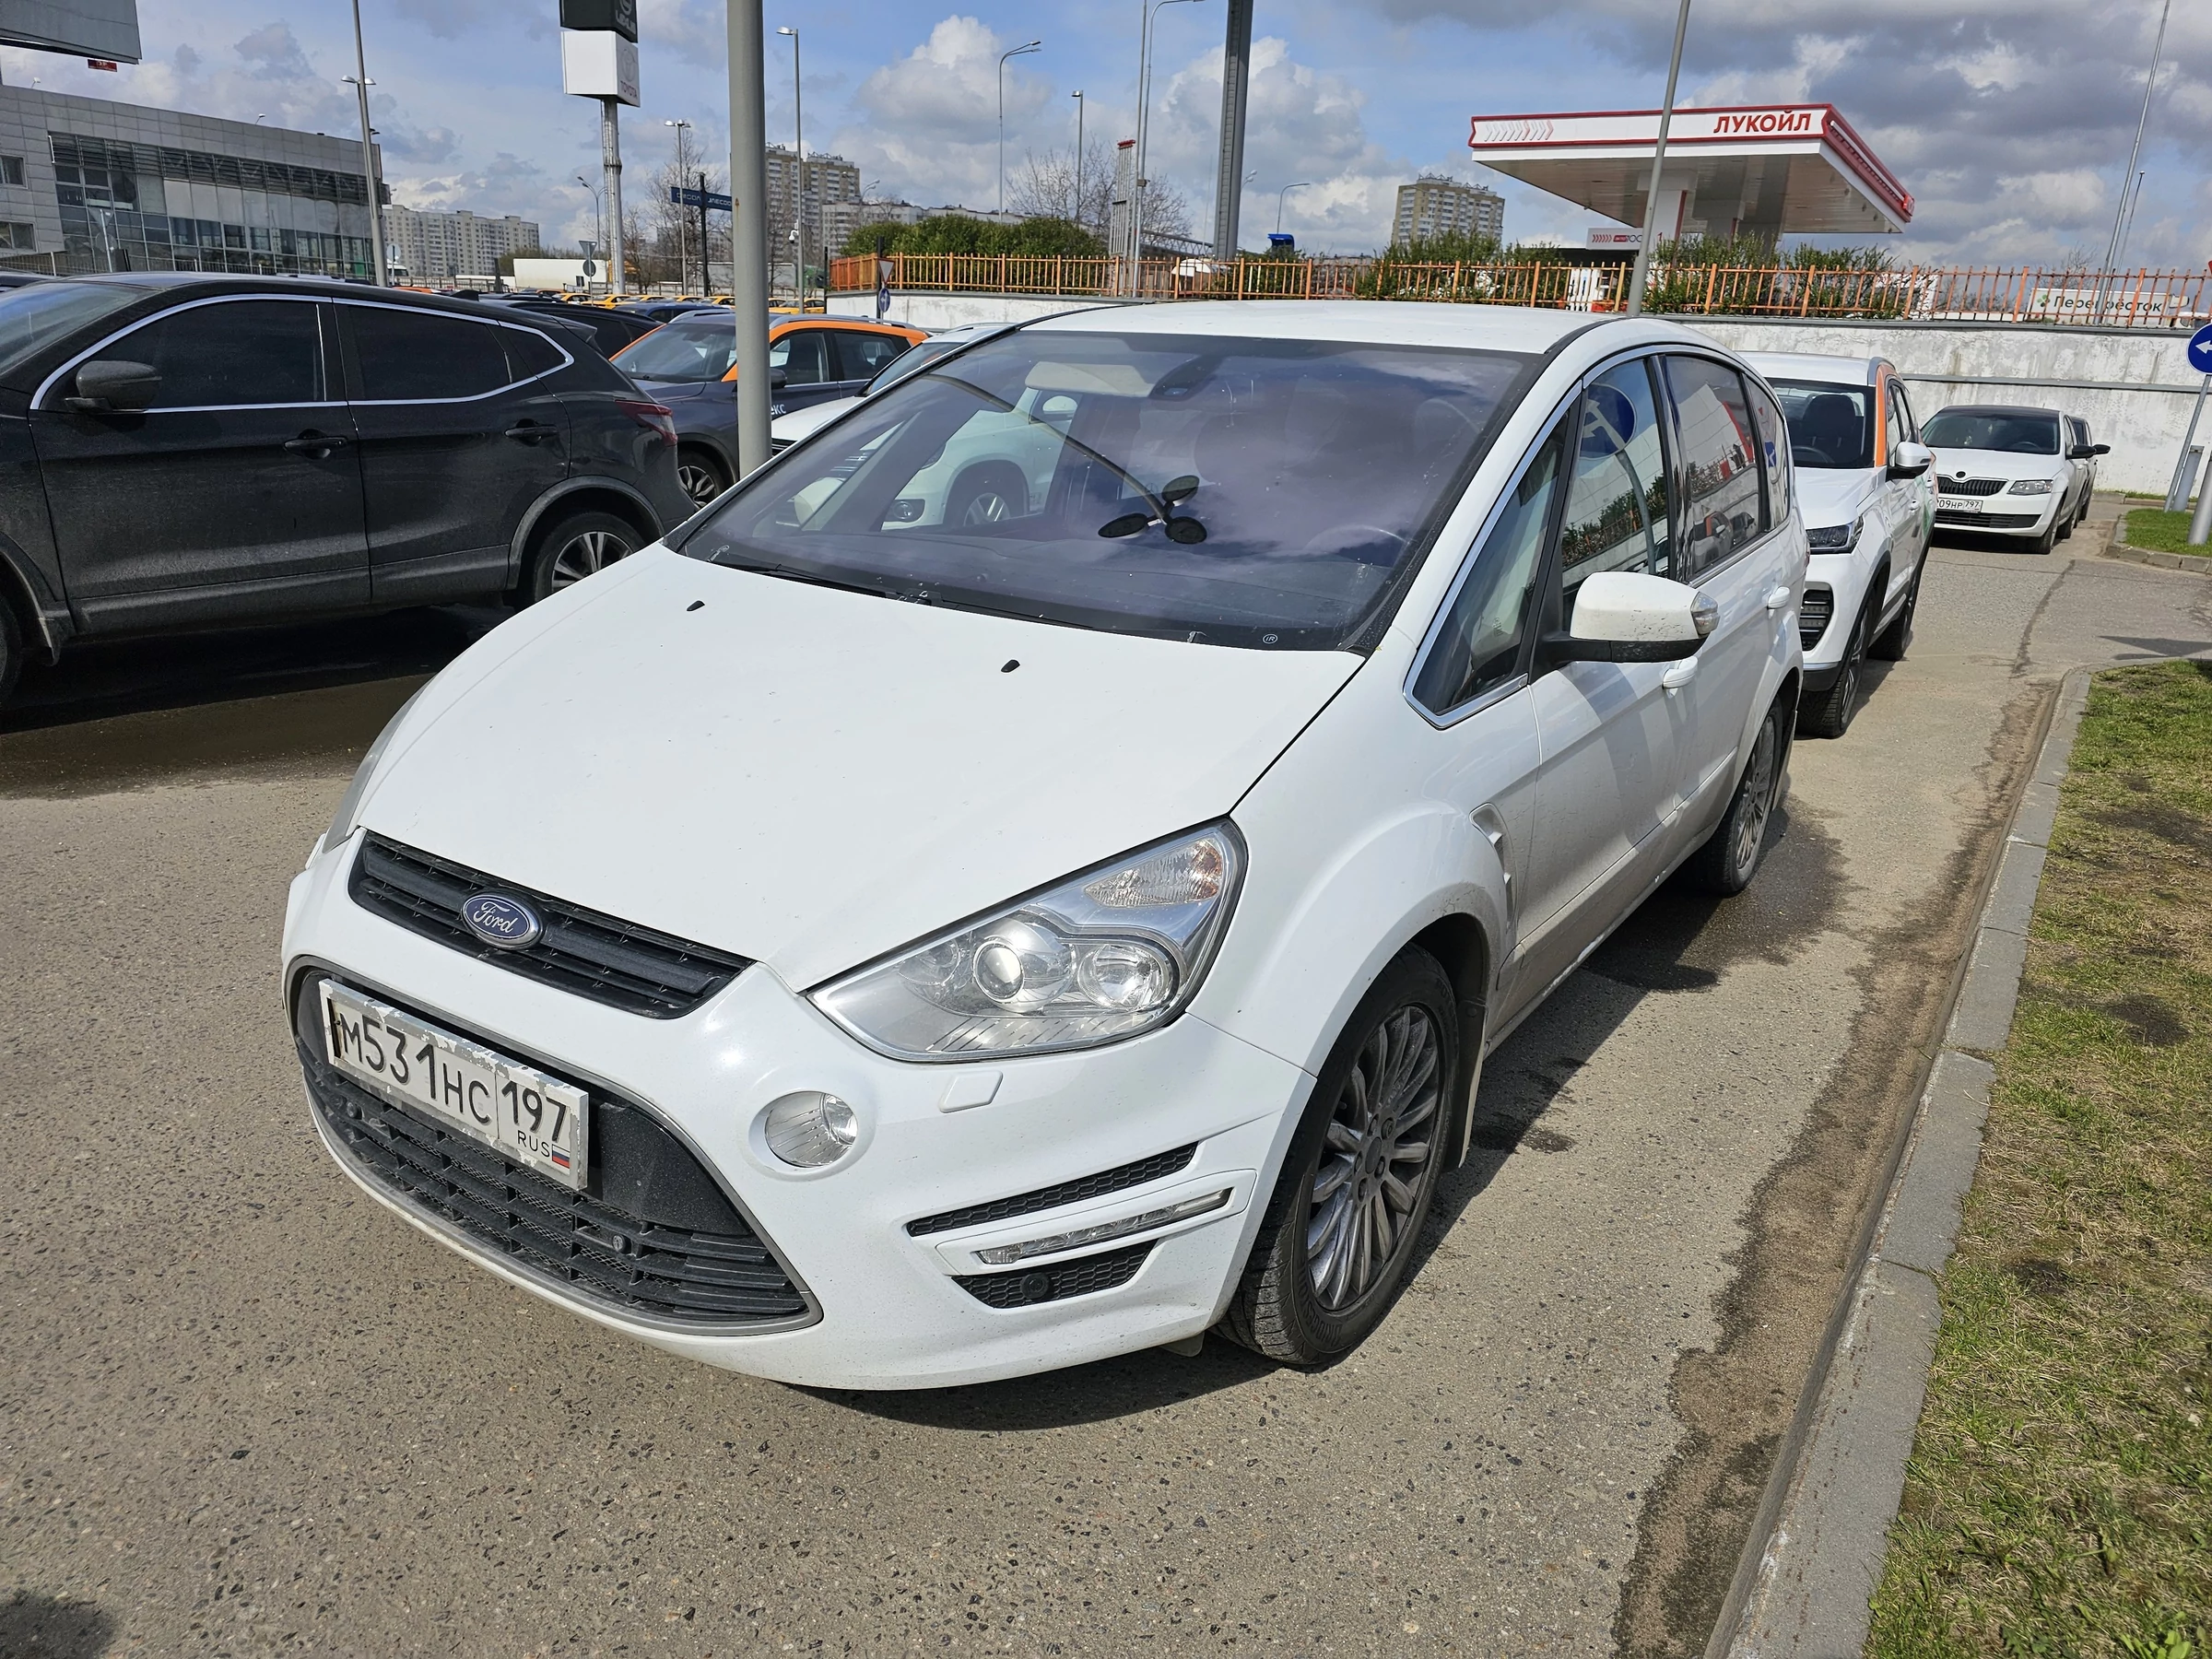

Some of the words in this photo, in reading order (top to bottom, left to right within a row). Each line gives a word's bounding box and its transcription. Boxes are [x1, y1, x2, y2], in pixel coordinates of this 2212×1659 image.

[620, 80, 638, 99] TOYOTA
[1712, 109, 1812, 134] ЛУКОЙЛ
[2053, 295, 2163, 312] Перерёсток
[1936, 499, 1963, 510] 09НР
[1965, 500, 1980, 509] 797
[473, 900, 519, 934] Ford
[339, 1012, 490, 1125] М531НС
[500, 1080, 567, 1143] 197
[517, 1130, 550, 1159] RUS
